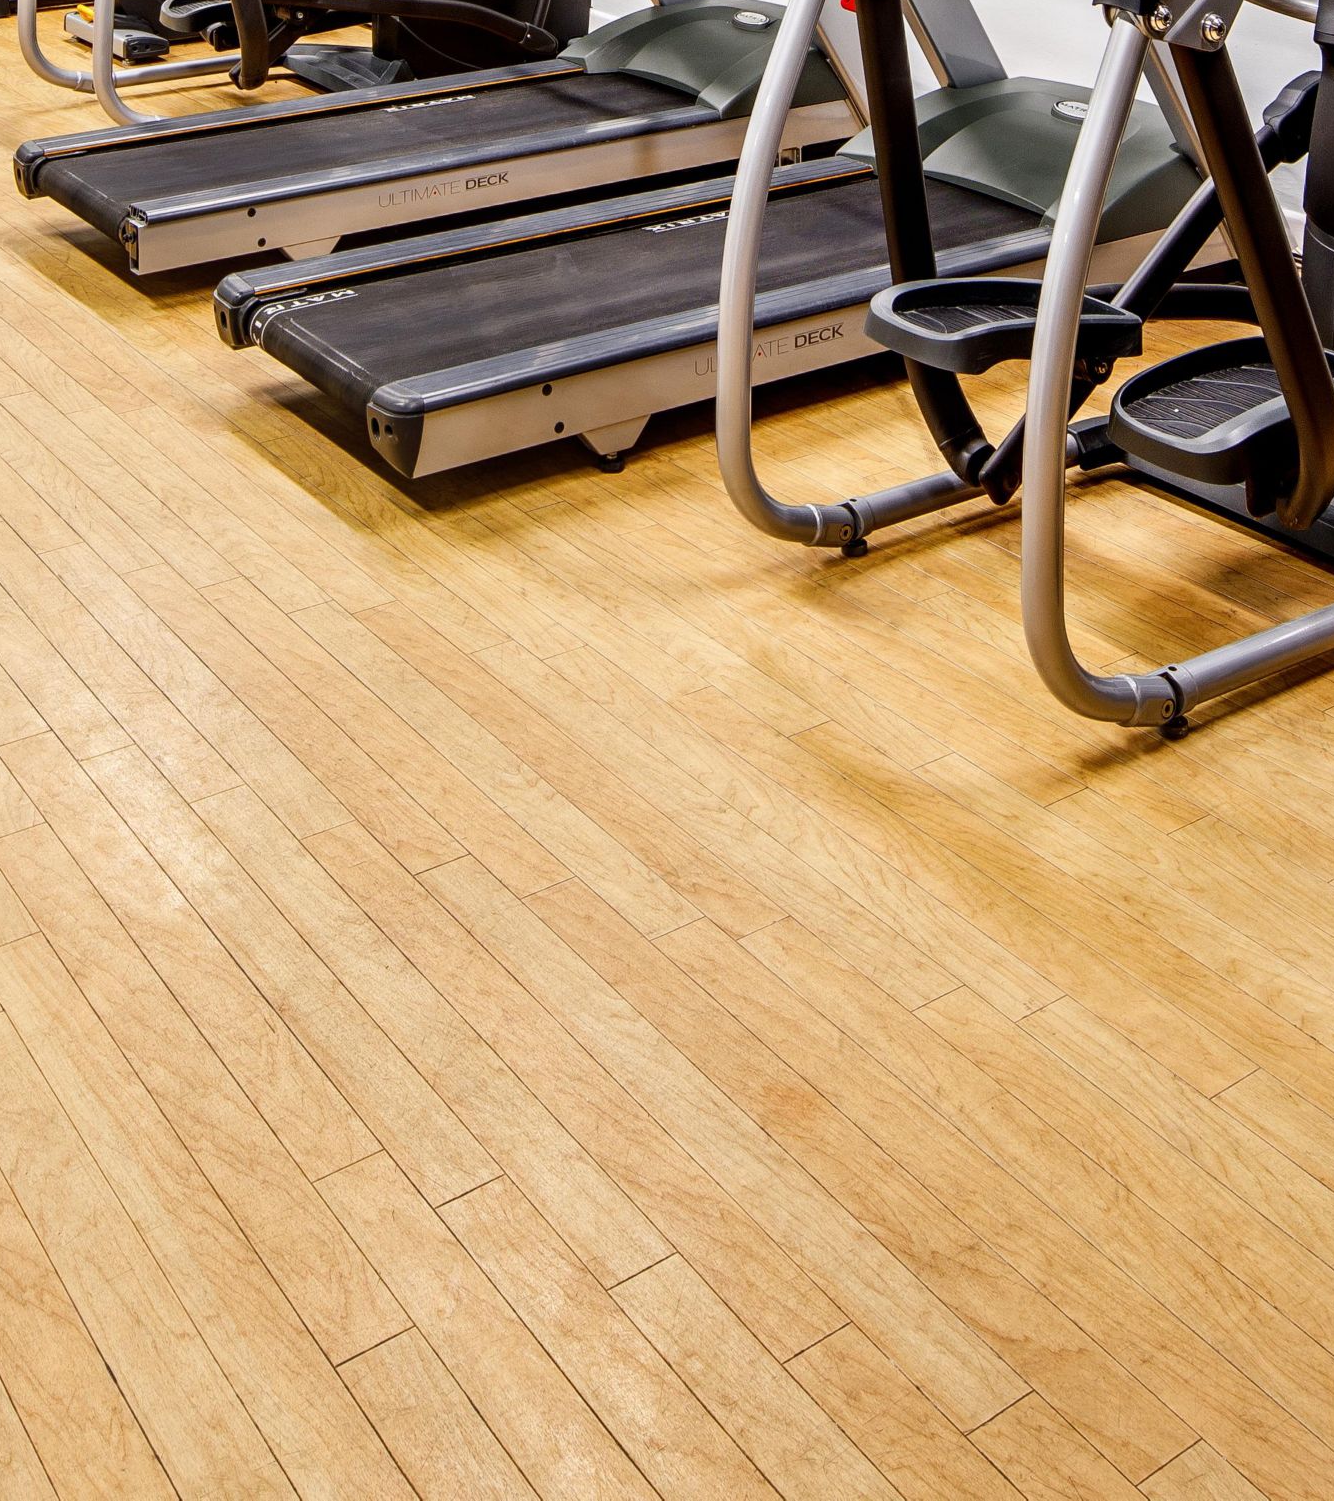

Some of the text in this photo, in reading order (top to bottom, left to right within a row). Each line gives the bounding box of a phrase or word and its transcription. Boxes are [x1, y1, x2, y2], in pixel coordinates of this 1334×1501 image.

[378, 171, 510, 208] ULTIMATE DECK
[694, 322, 844, 377] ULATE DECK
